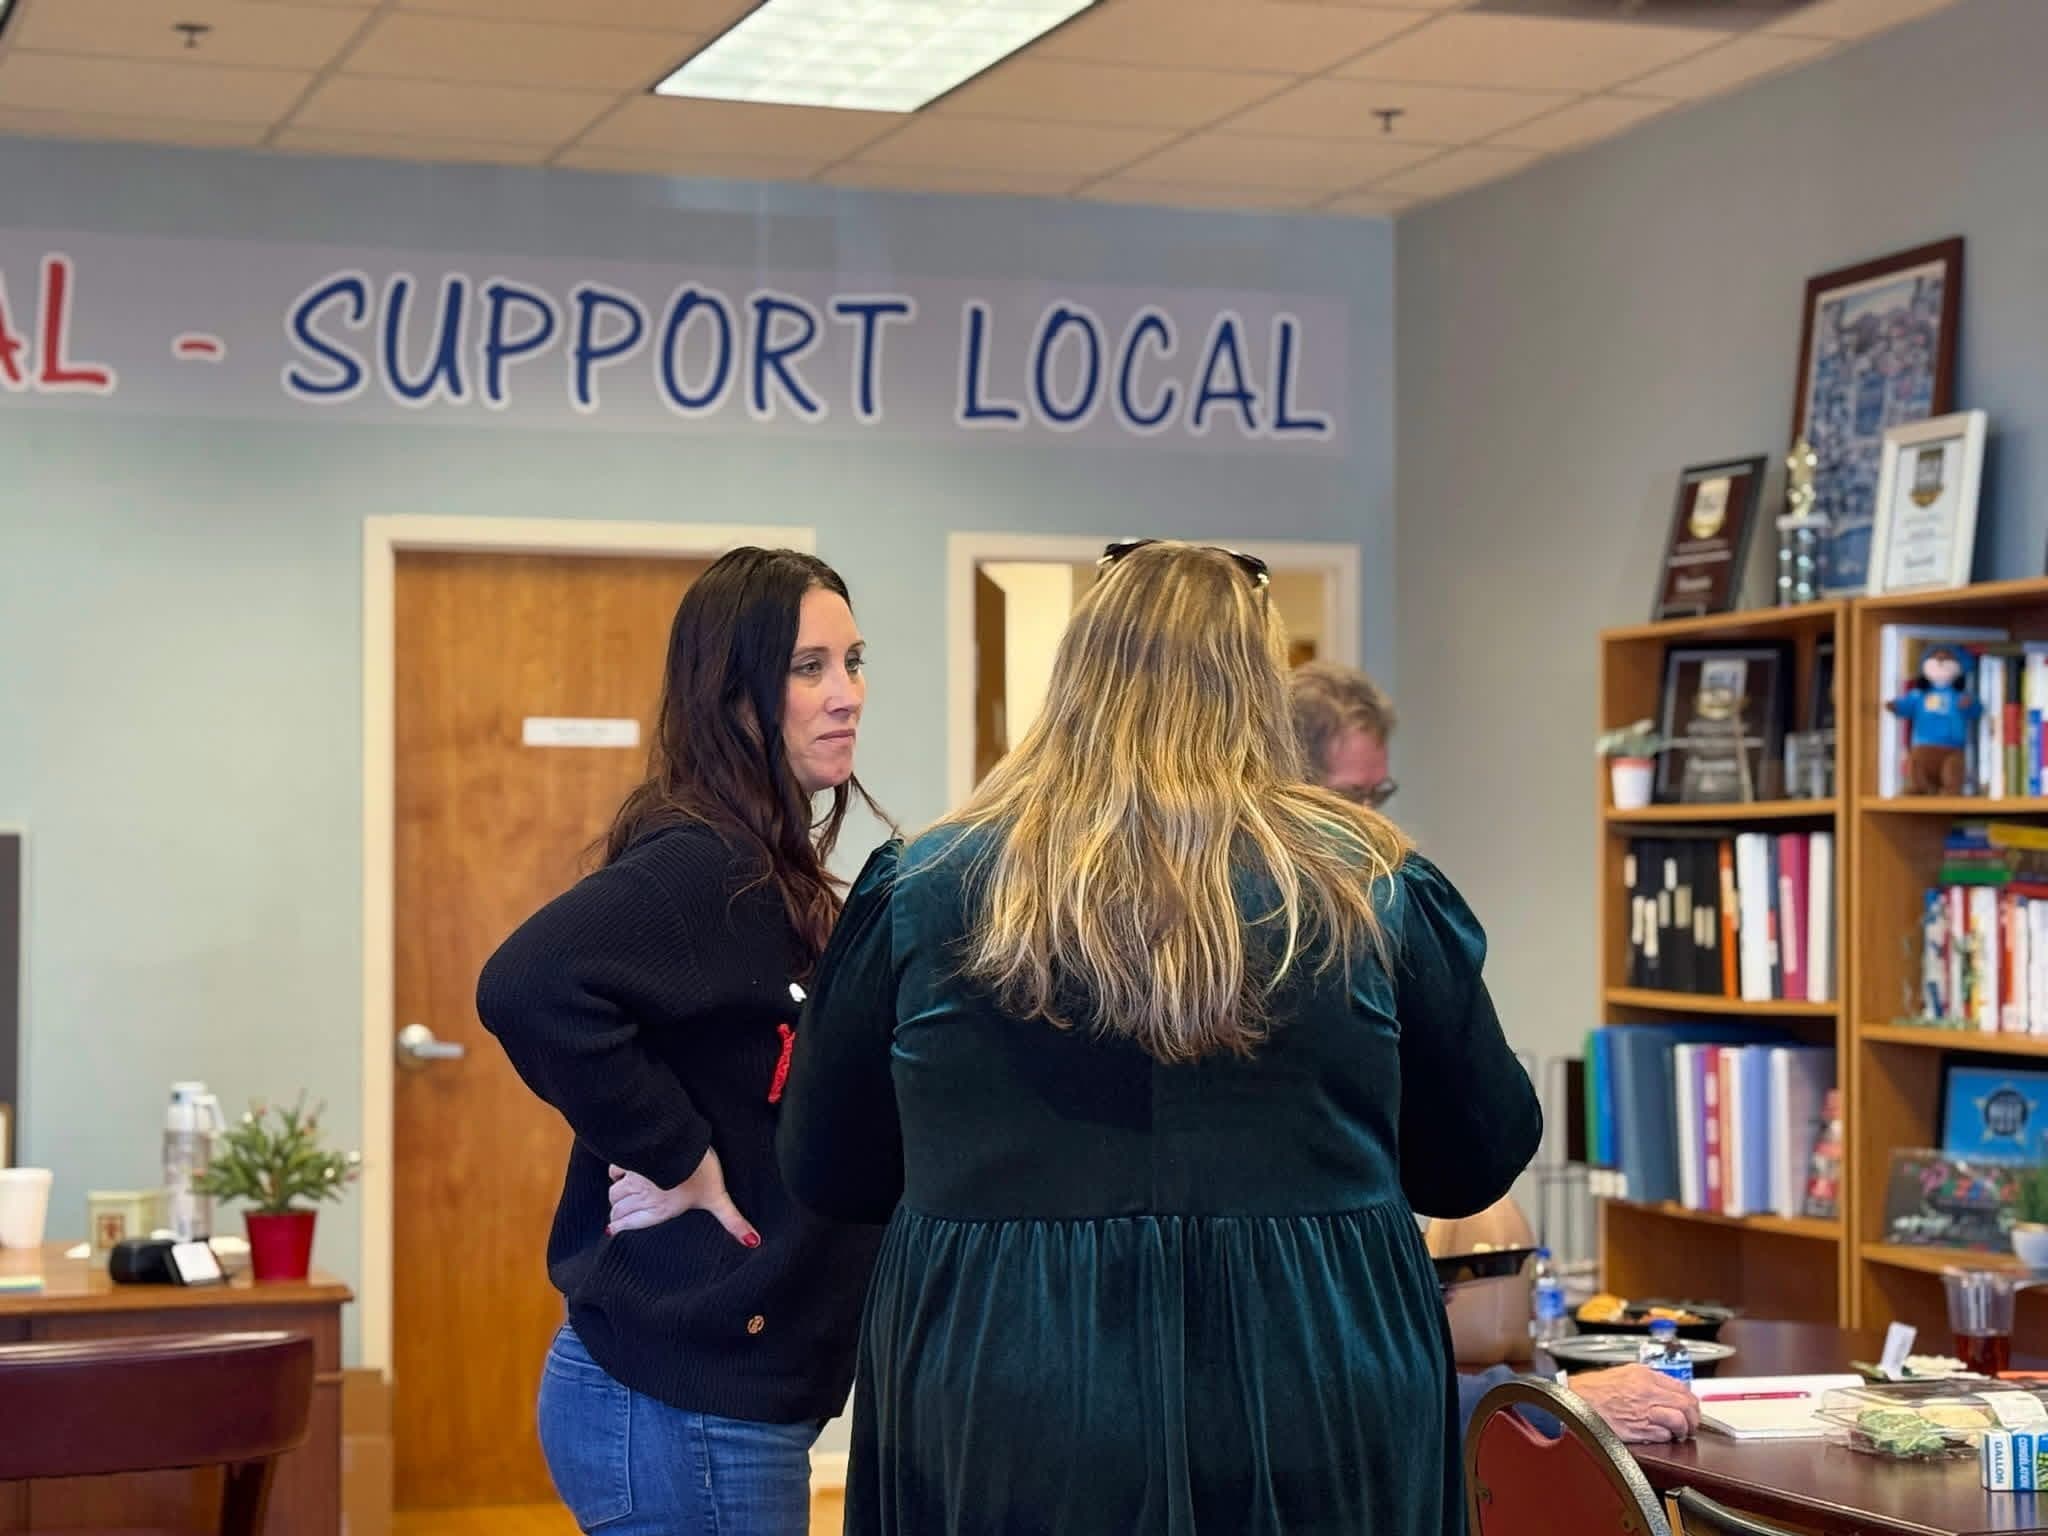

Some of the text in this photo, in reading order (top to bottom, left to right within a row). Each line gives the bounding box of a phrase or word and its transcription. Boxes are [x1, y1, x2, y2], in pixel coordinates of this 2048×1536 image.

[287, 275, 911, 416] SUPPORT
[960, 302, 1329, 432] LOCAL
[1995, 1441, 2005, 1484] GALLON
